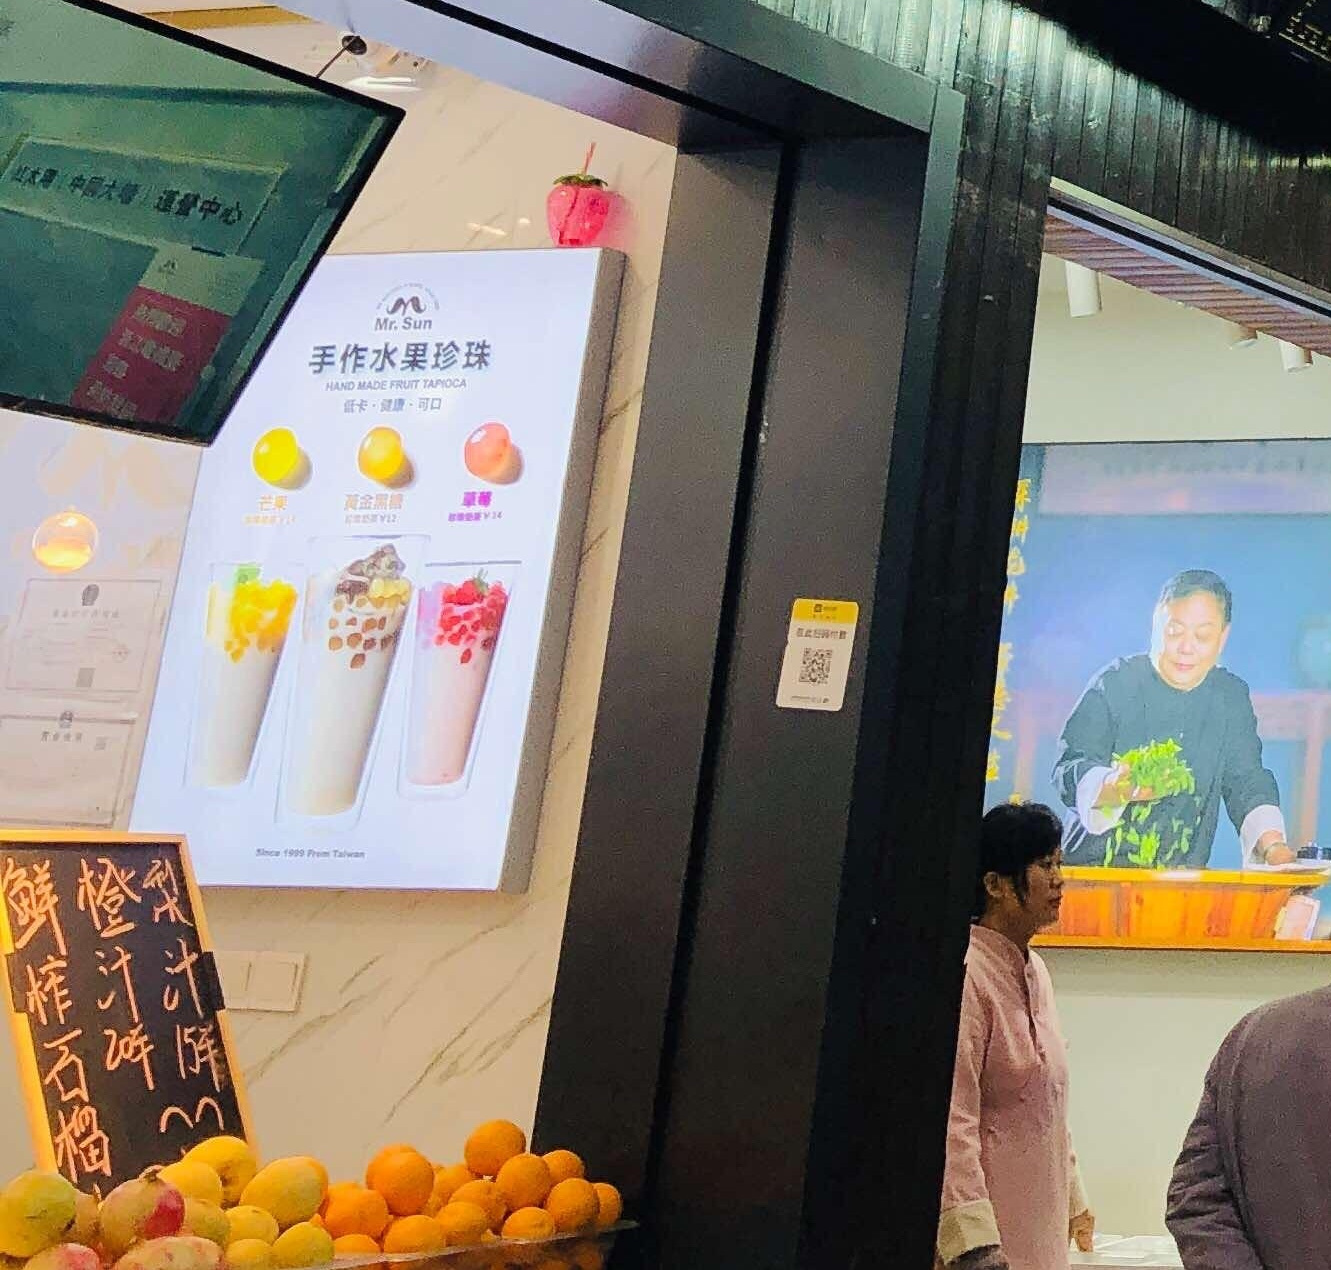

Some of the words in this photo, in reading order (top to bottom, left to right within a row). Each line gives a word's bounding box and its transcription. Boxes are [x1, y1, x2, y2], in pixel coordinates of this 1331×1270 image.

[375, 317, 398, 331] Mr.
[402, 317, 432, 331] Sun
[309, 339, 491, 375] 手作水果珍珠
[325, 381, 356, 392] HAND
[357, 380, 387, 391] MADE
[390, 379, 419, 390] FRUIT
[423, 378, 467, 390] TAPIOCA
[258, 495, 288, 512] 芒果
[2, 857, 111, 1204] 鲜榨石榴
